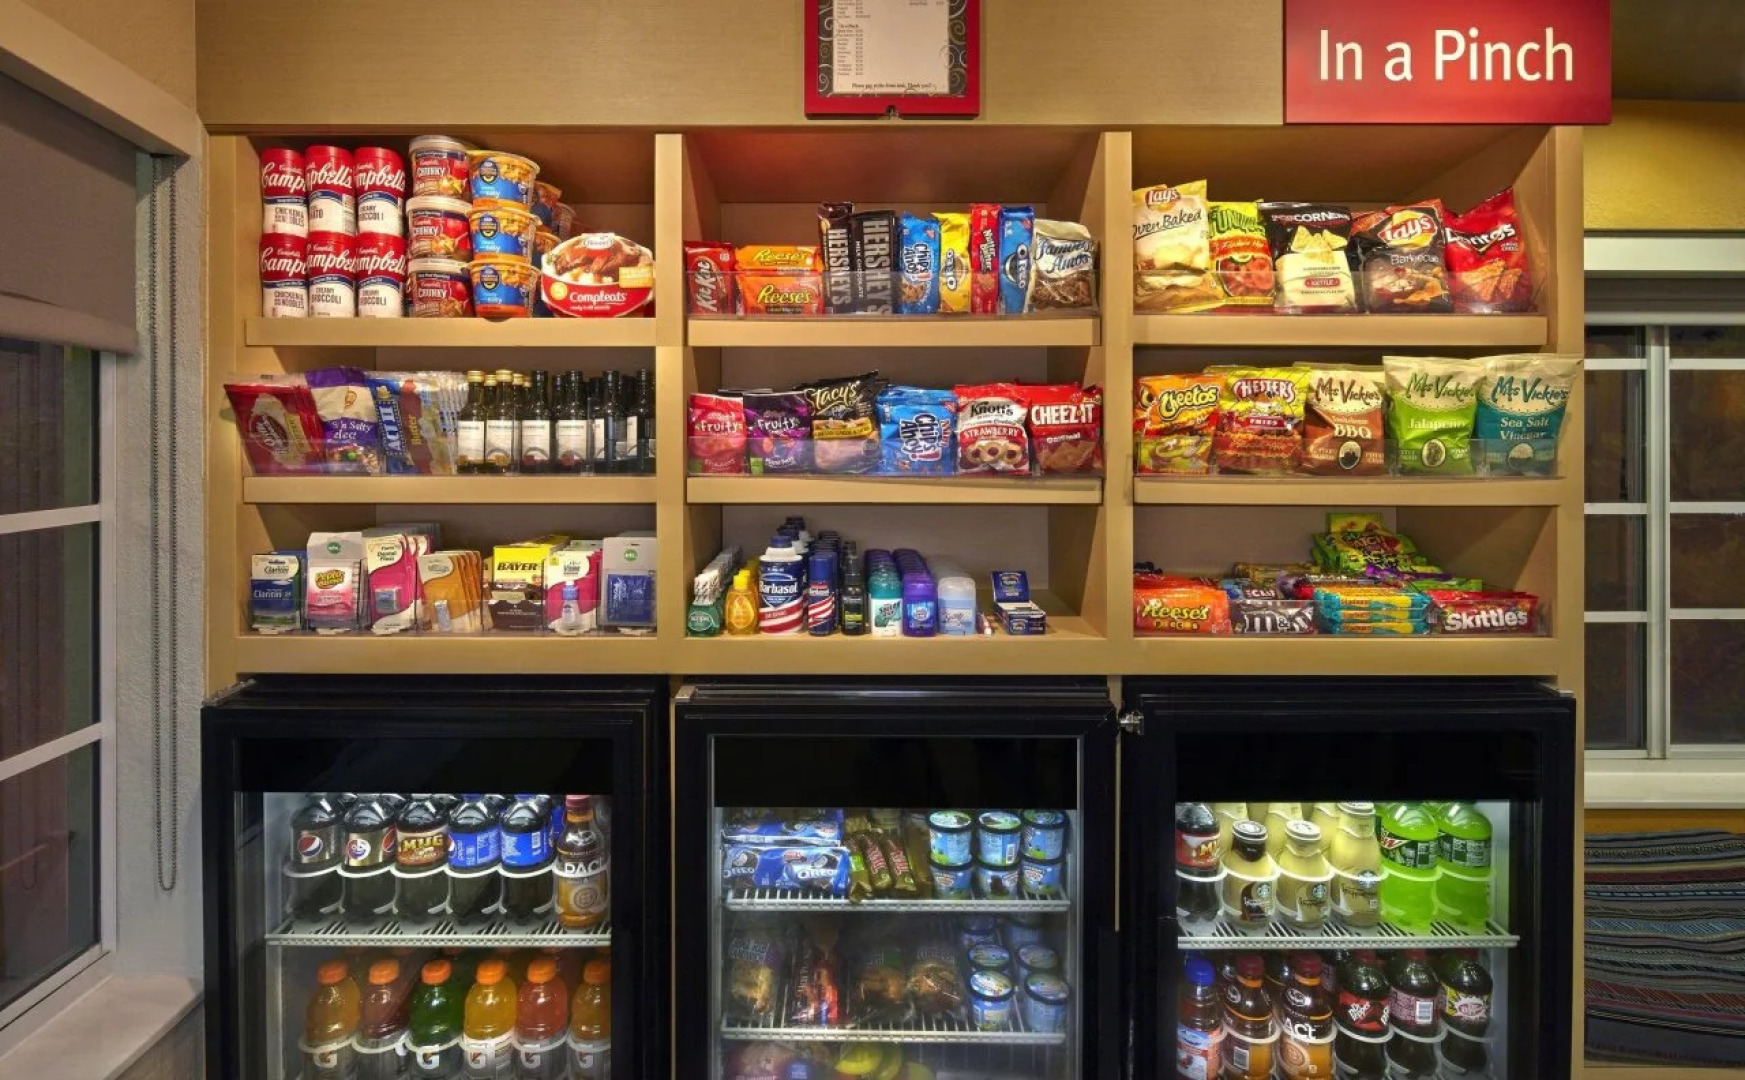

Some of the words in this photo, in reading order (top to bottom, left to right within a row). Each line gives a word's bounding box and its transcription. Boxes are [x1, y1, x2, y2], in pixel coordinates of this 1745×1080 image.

[1320, 29, 1363, 80] In
[1384, 41, 1413, 82] a
[1435, 26, 1573, 81] Pinch
[262, 162, 305, 193] Camp
[417, 167, 446, 177] CHUNKY
[1163, 211, 1203, 229] Baked
[412, 226, 440, 236] CHUNKY
[1444, 223, 1517, 246] Doritos
[982, 228, 996, 262] Nutter
[1035, 233, 1091, 259] Famous
[262, 247, 306, 277] Camp
[754, 249, 809, 263] Reese's
[914, 243, 929, 278] Chips
[1052, 251, 1093, 273] Amos
[1391, 254, 1440, 265] Barbecue
[945, 249, 958, 291] OREO
[1016, 243, 1029, 290] OREO
[418, 288, 448, 299] CHUNKY
[570, 289, 628, 305] Compleats
[757, 284, 812, 304] Reese's
[804, 380, 860, 408] Stacy's
[1339, 379, 1381, 406] Vickie's
[1521, 377, 1571, 405] Vickie's
[970, 401, 1014, 417] Knott's
[1158, 385, 1219, 420] Cheetos
[408, 414, 422, 445] Butter
[700, 420, 739, 433] Fruity
[757, 418, 796, 431] Fruity
[1333, 423, 1373, 439] BBQ
[1408, 418, 1466, 431] Jalapeño
[1500, 417, 1523, 428] Sea
[1526, 416, 1550, 428] Salt
[913, 413, 937, 452] Chips
[963, 426, 1019, 439] STRAWBERRY
[1500, 430, 1546, 441] Vinegar
[497, 562, 538, 571] BAYER
[759, 581, 798, 595] Barbasol
[1141, 602, 1211, 620] Reese's
[1444, 608, 1528, 631] Skittles
[402, 835, 443, 850] MUG
[564, 859, 601, 875] PAC
[797, 869, 836, 879] OREO
[415, 1043, 440, 1070] G
